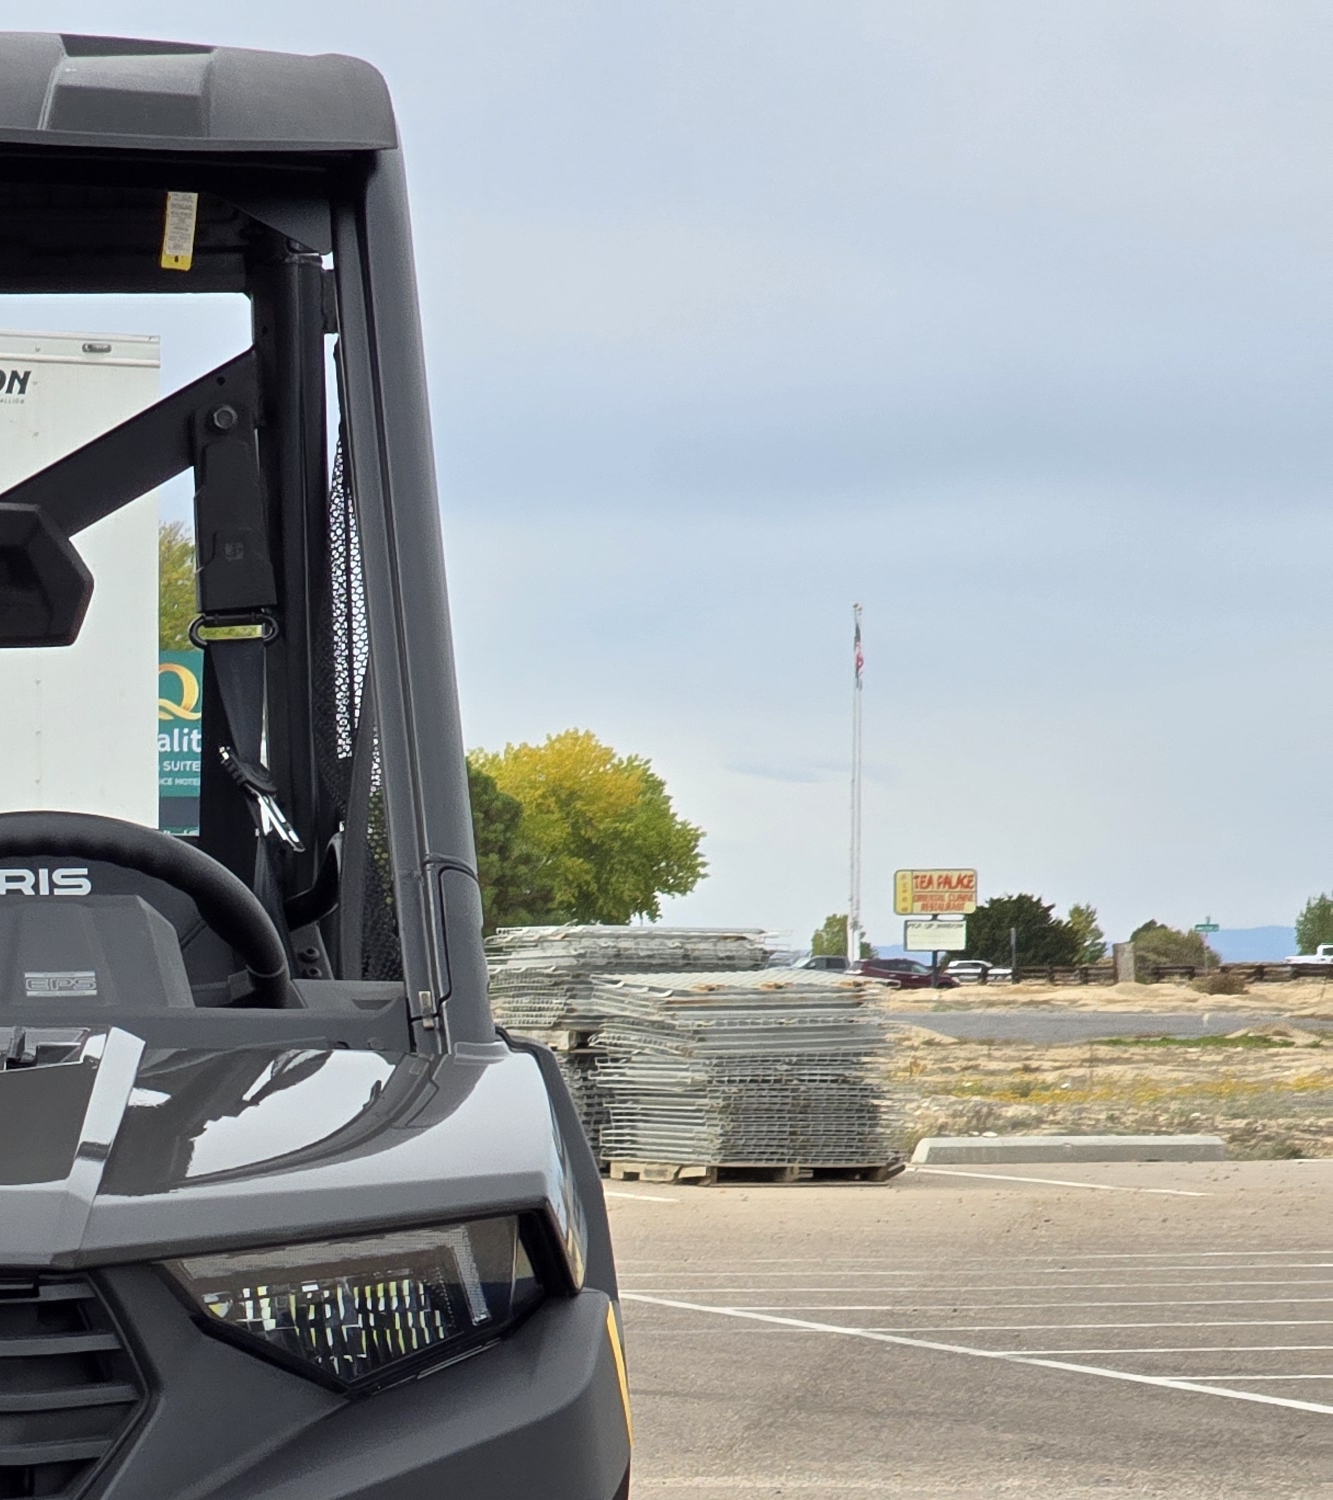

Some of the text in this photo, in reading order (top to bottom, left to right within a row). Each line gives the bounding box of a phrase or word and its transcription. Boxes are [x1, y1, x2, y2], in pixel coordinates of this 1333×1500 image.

[158, 728, 201, 752] alit
[163, 761, 200, 771] SUITE
[914, 873, 975, 889] TEA PALACE
[25, 977, 97, 991] EPS
